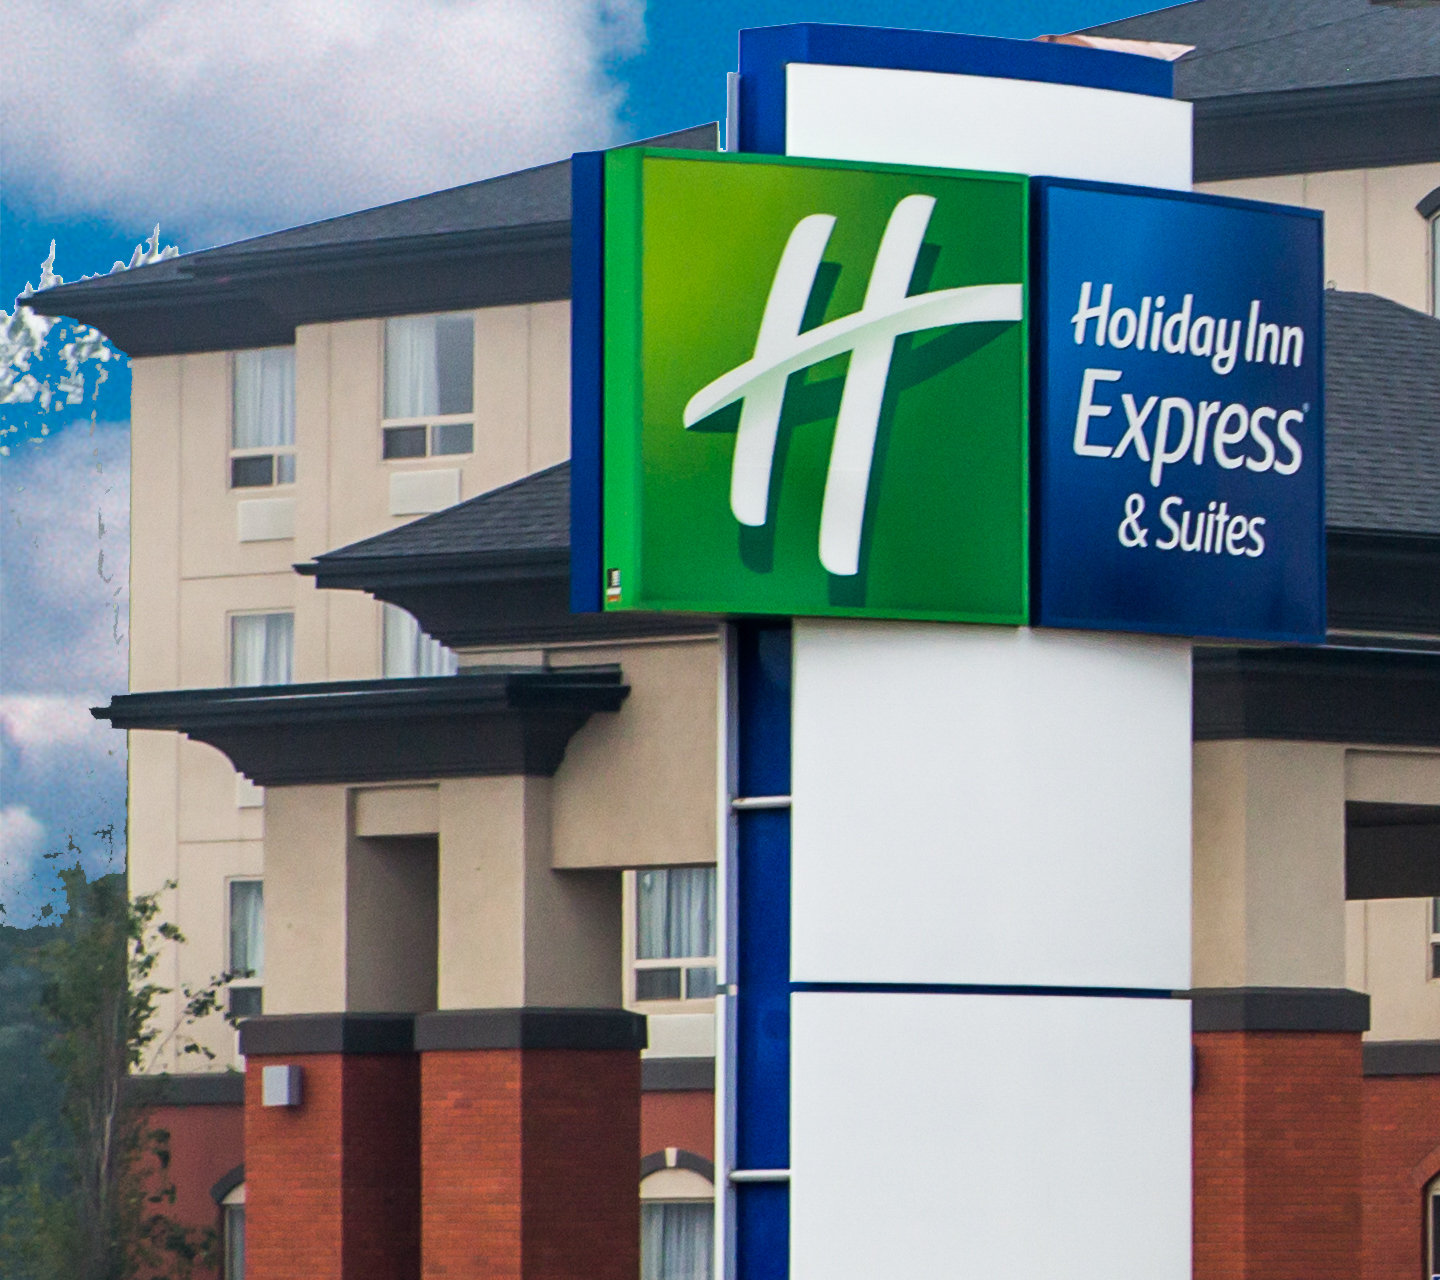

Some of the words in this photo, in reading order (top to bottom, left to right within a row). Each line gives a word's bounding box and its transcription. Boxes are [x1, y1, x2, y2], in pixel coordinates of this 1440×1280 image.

[1071, 281, 1242, 376] Holiday
[1245, 299, 1304, 368] Inn
[1073, 368, 1304, 488] Express
[1117, 492, 1149, 548] &
[1155, 495, 1267, 558] Suites
